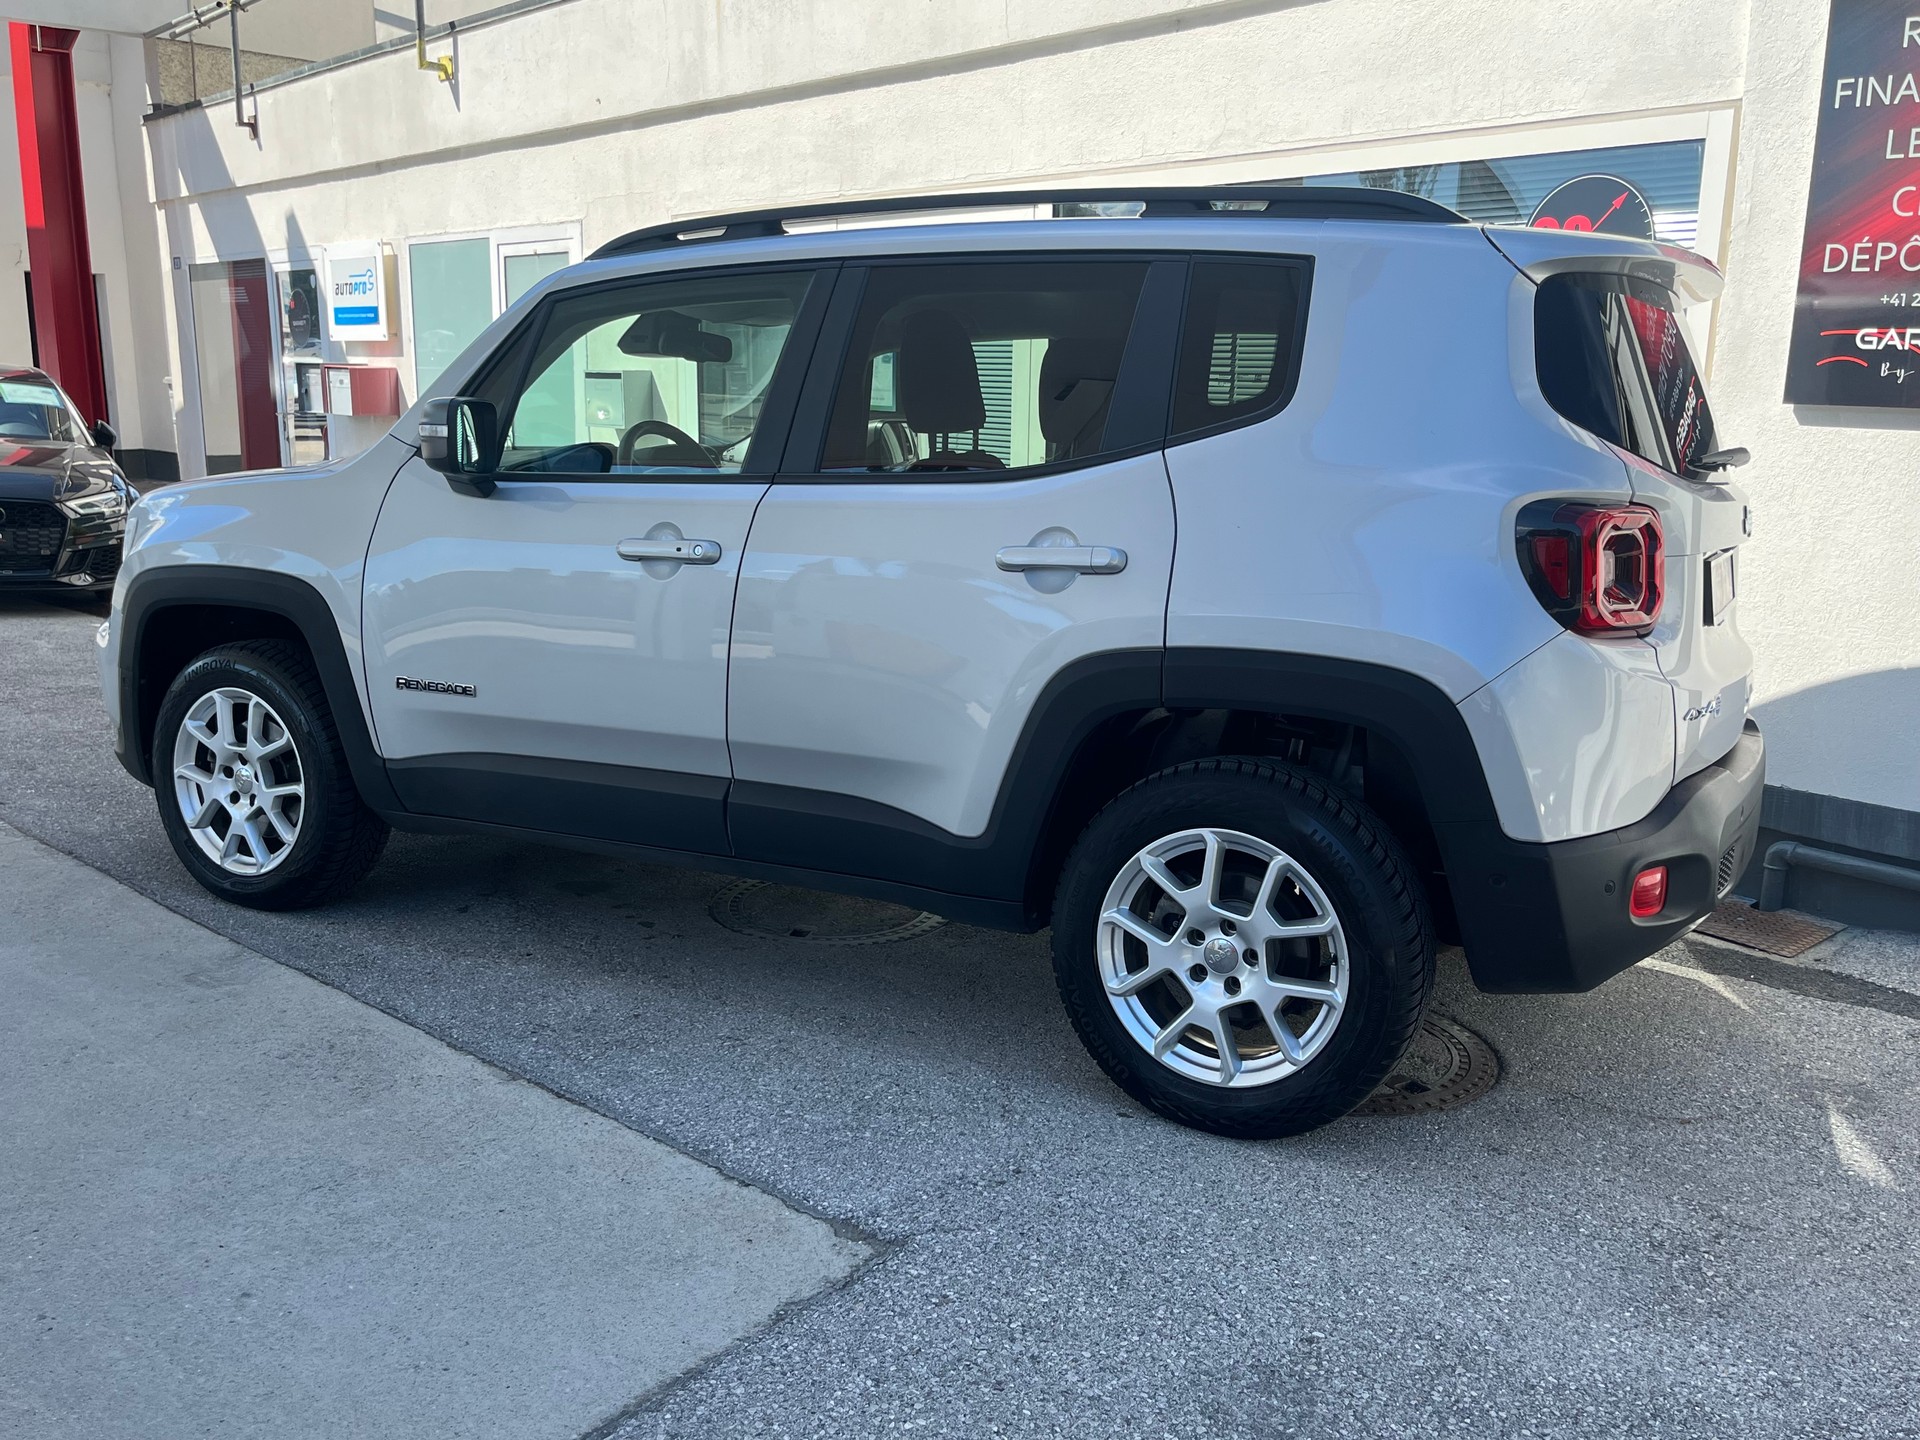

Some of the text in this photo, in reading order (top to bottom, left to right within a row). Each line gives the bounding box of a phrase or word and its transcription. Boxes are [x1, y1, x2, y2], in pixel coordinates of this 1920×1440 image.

[1834, 73, 1920, 109] FINA
[1880, 293, 1907, 307] +41
[1880, 362, 1915, 384] By
[184, 658, 239, 683] UNIROYAL
